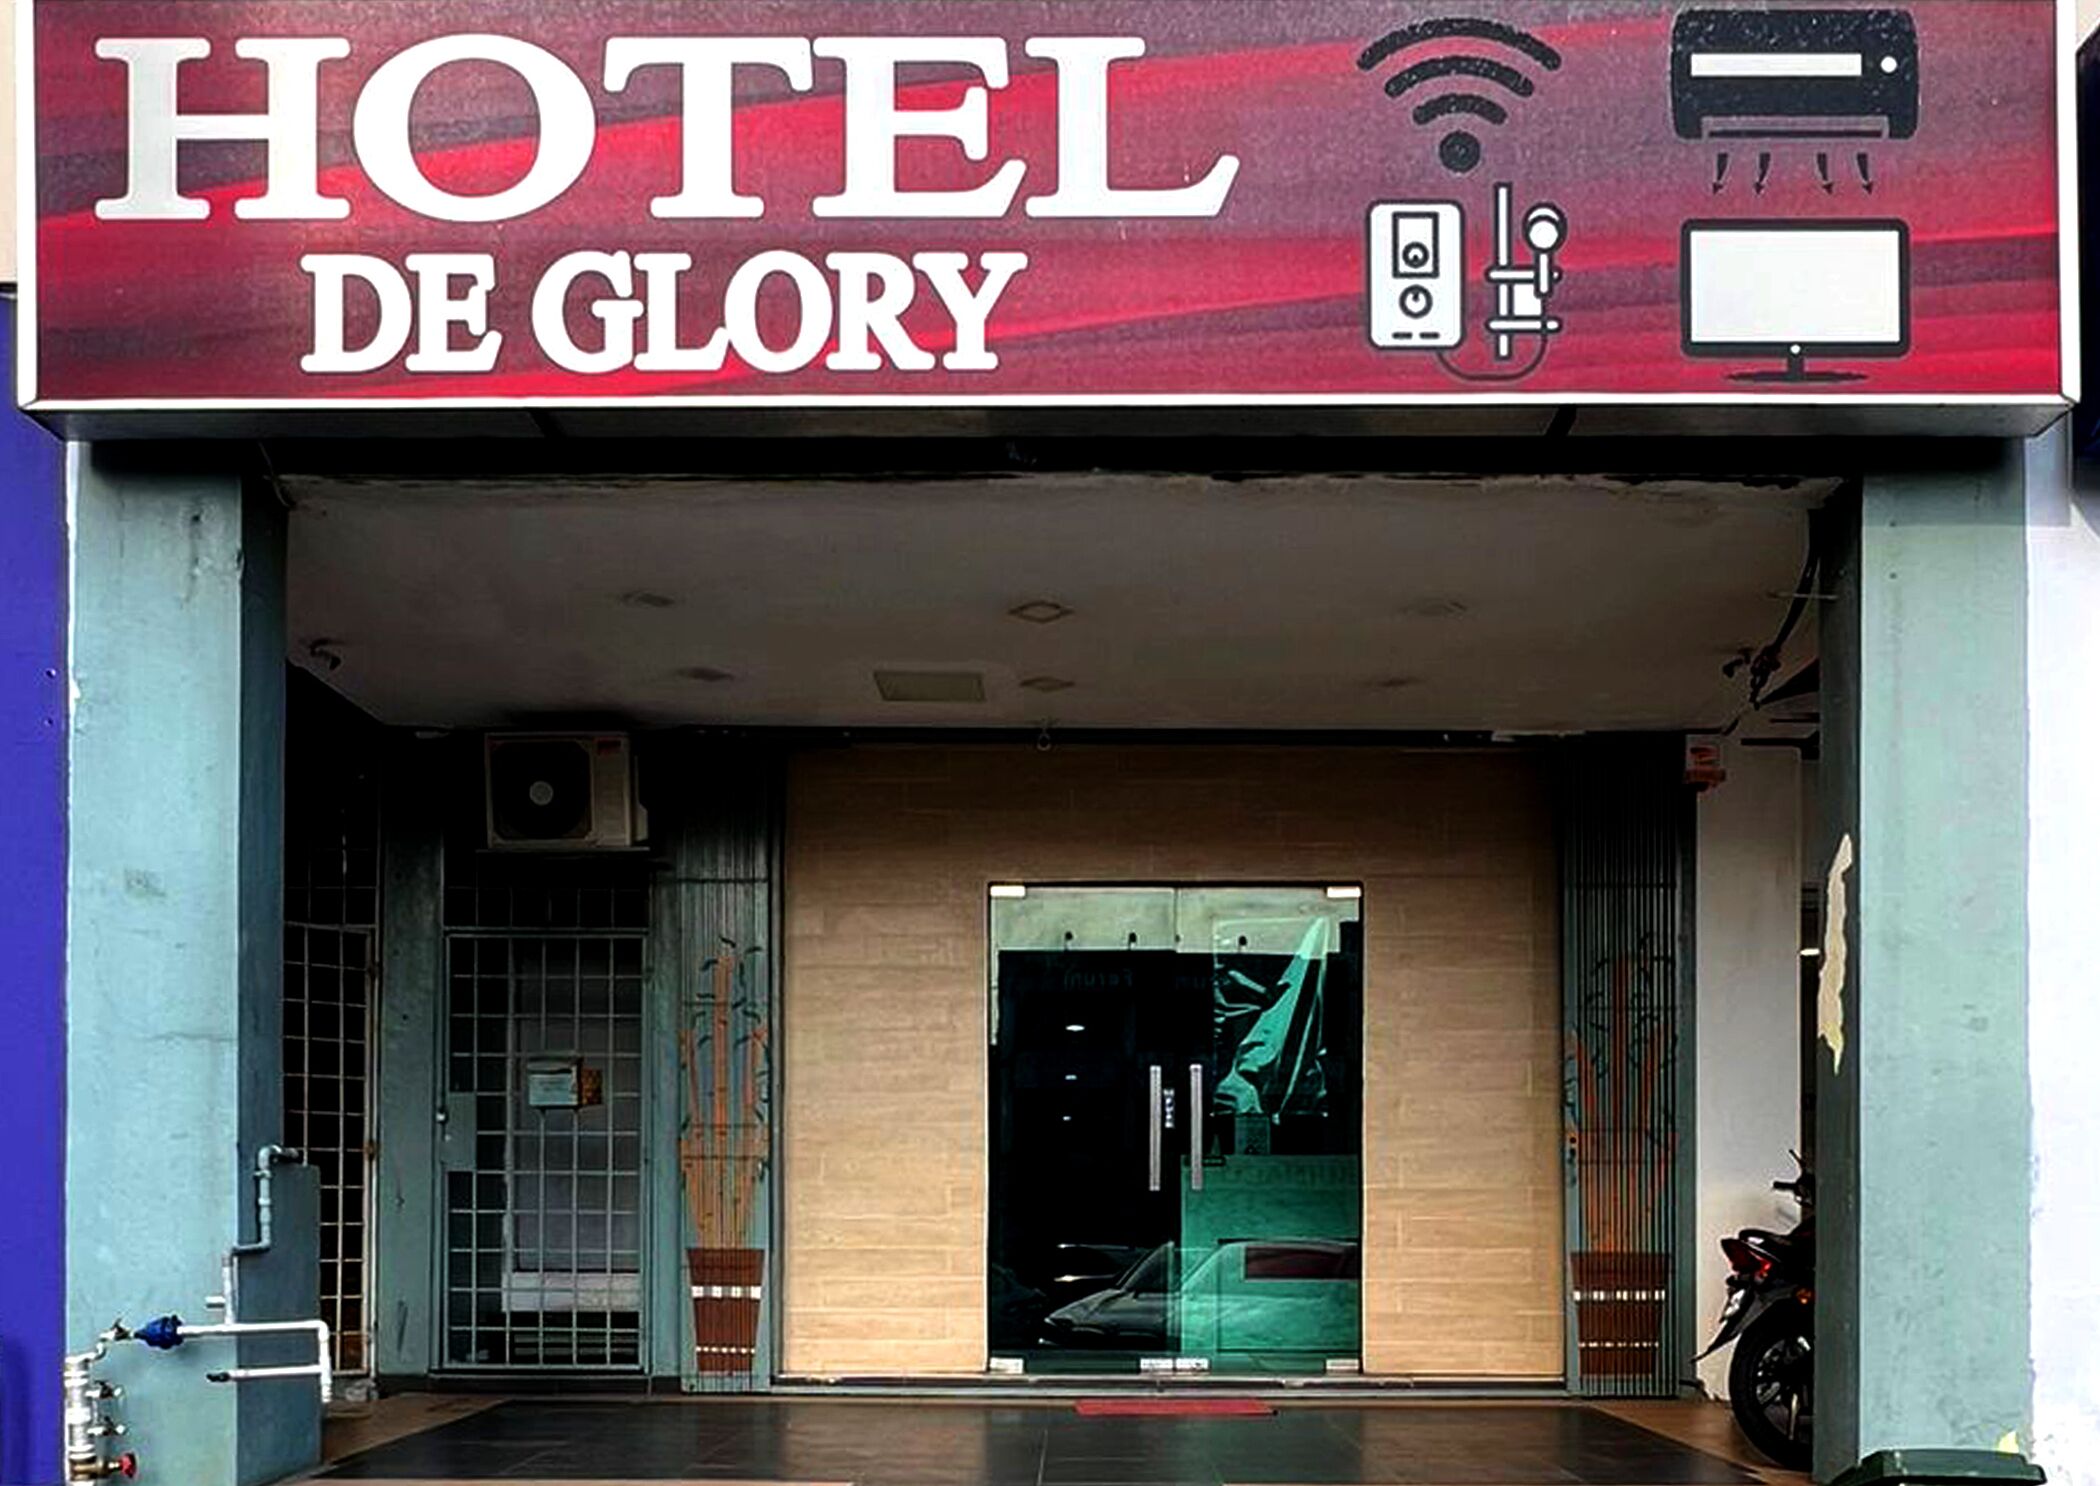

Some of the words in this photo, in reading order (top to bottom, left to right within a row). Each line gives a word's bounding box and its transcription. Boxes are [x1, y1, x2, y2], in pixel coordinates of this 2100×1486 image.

[94, 34, 1239, 221] HOTEL
[300, 253, 502, 373] DE
[531, 250, 1028, 374] GLORY
